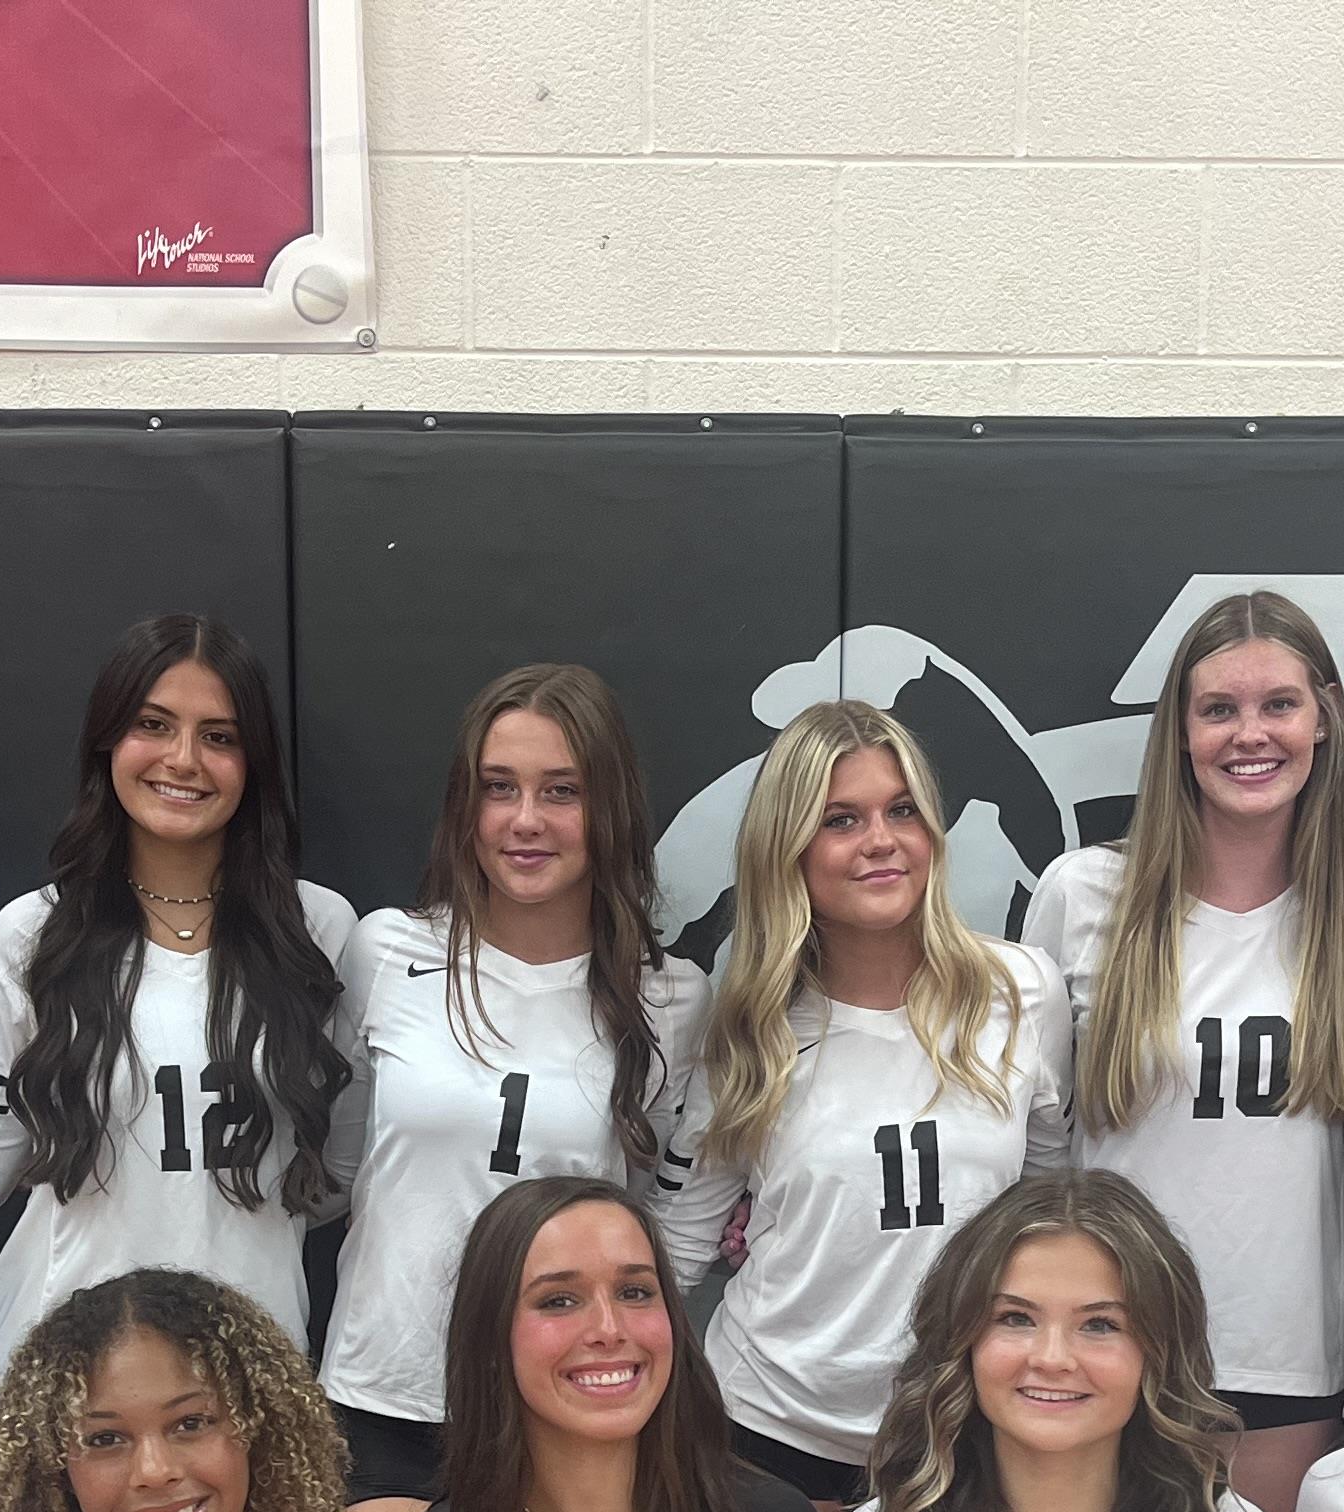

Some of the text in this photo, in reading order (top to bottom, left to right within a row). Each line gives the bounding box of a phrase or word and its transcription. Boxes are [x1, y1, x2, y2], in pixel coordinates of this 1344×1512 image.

[186, 262, 219, 272] STUDIOS
[187, 253, 256, 263] NATIONAL SCHOOL
[154, 1060, 256, 1172] 12
[1192, 1015, 1291, 1120] 10
[489, 1072, 530, 1176] 1
[873, 1119, 945, 1231] 11
